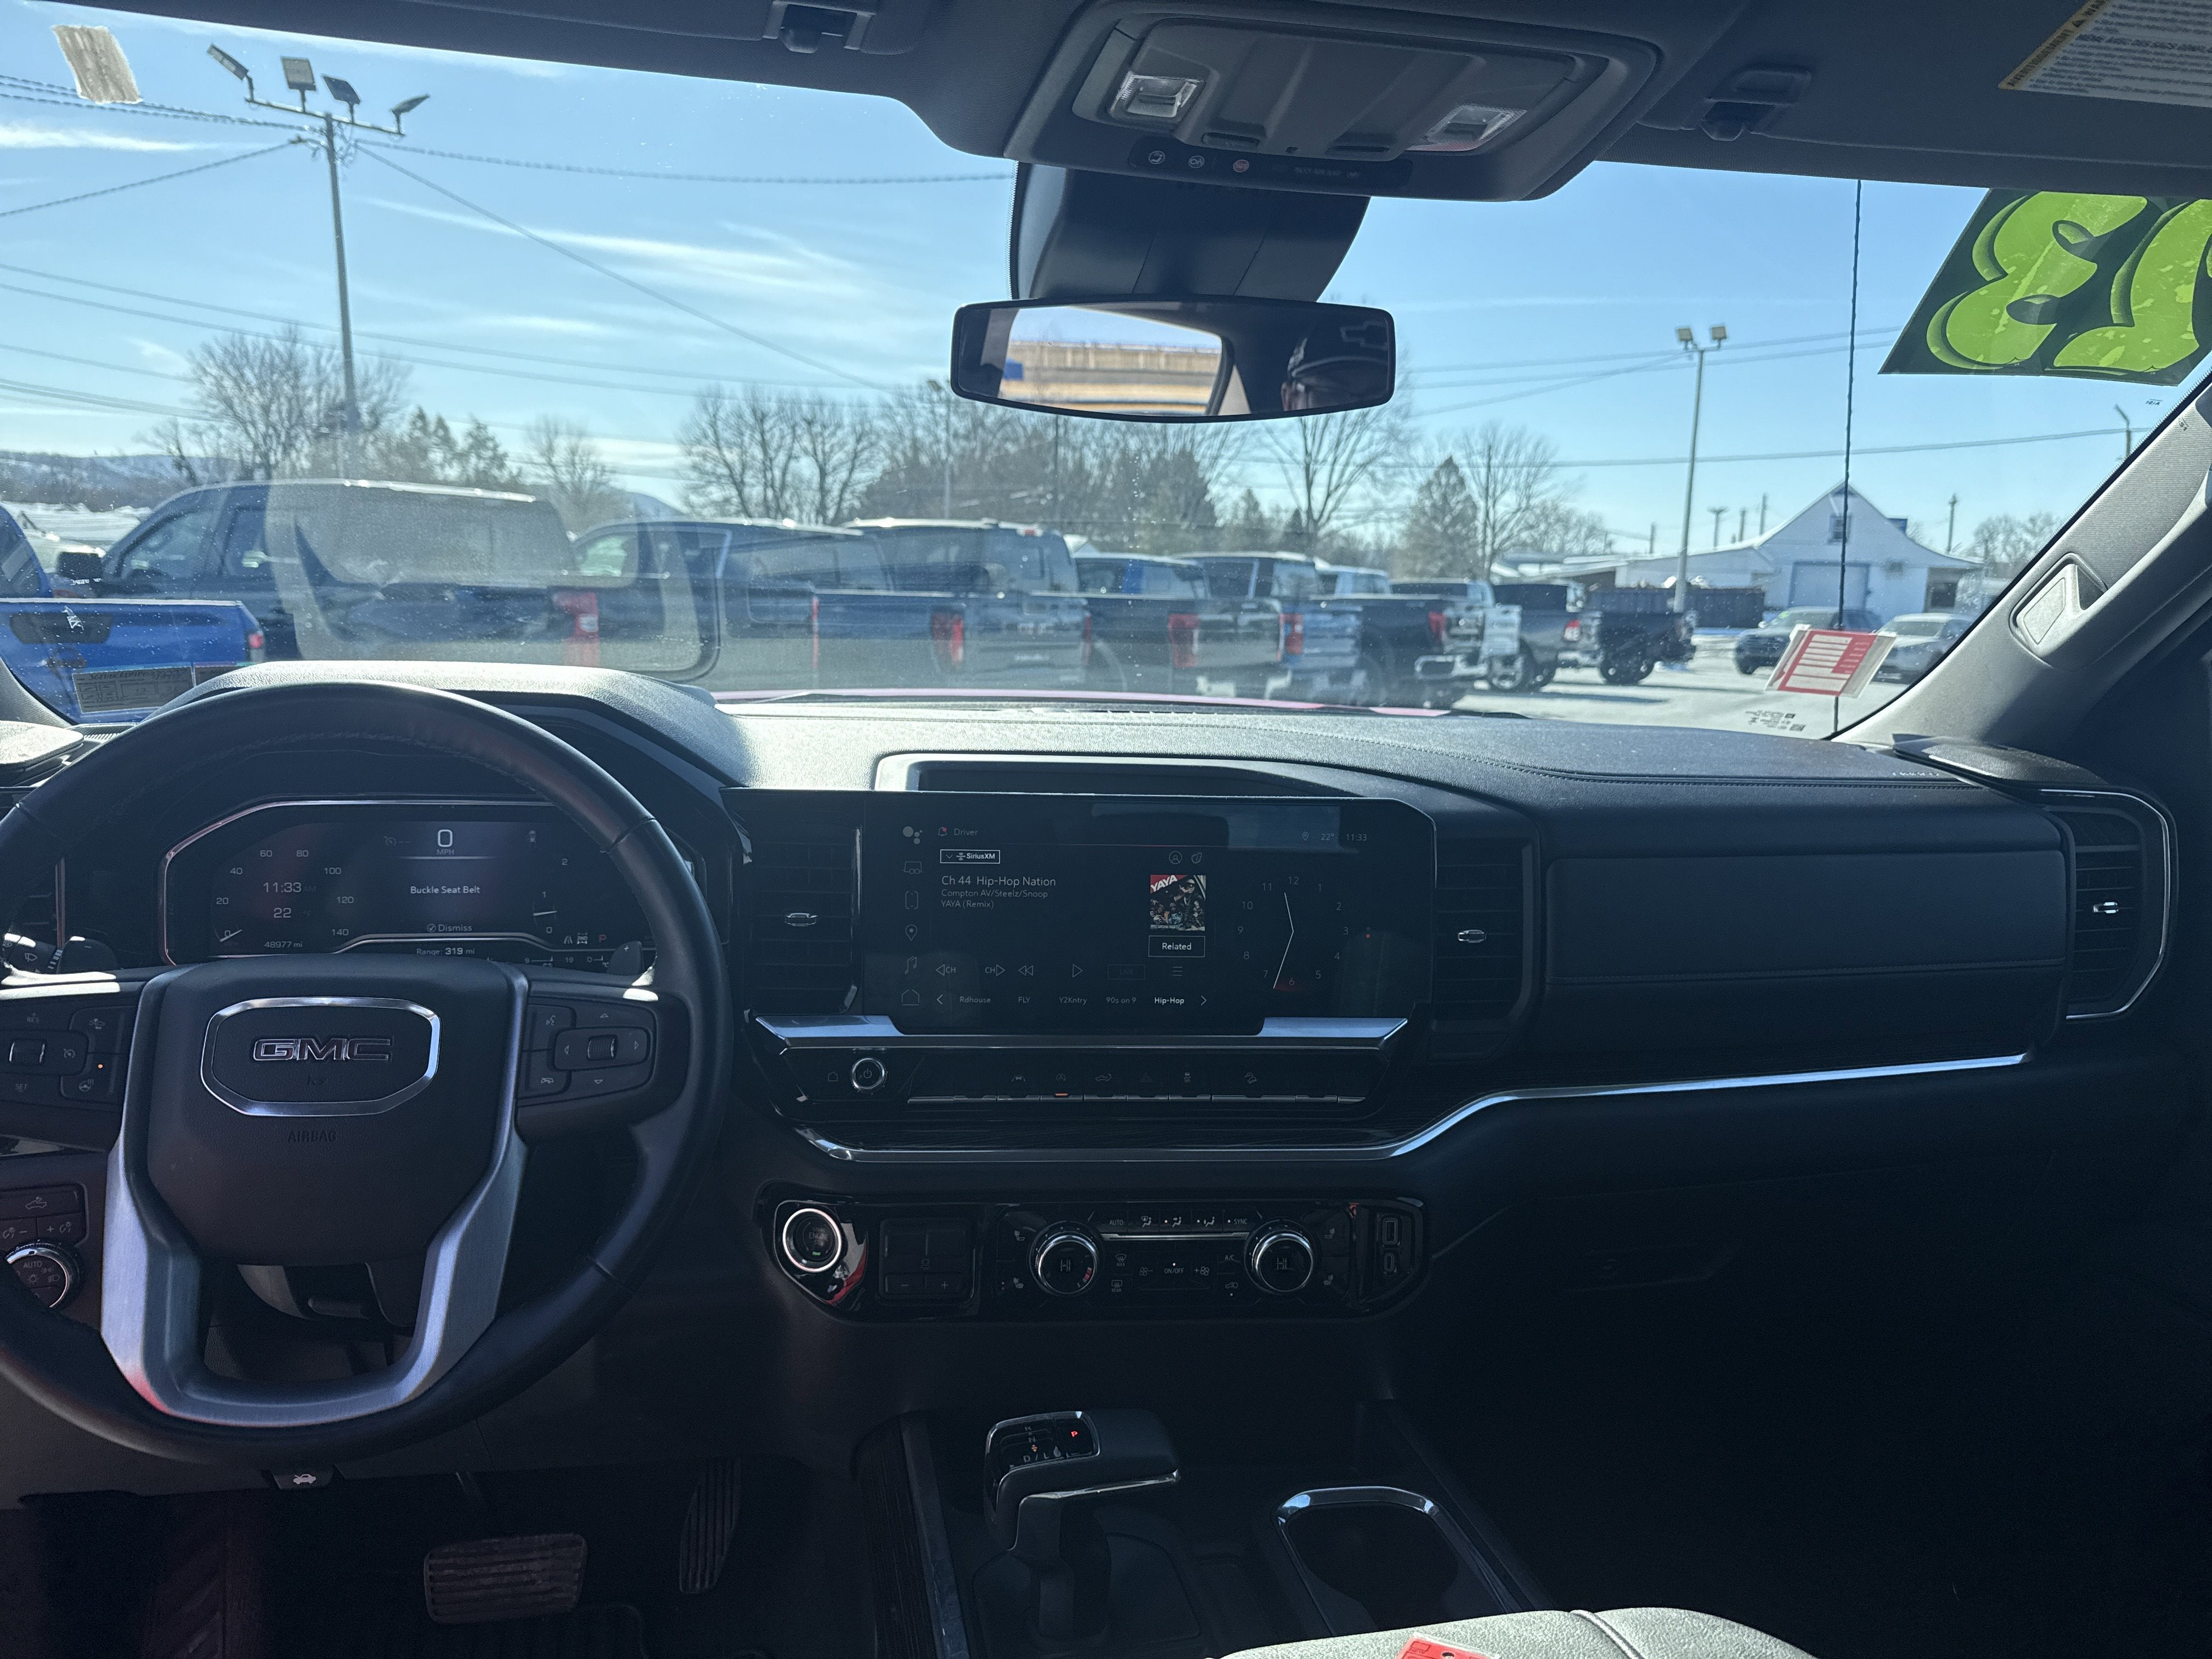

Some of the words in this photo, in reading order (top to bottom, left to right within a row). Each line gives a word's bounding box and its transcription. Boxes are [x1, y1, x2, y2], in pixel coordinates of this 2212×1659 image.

[953, 828, 978, 836] Driver
[437, 829, 453, 847] 0
[941, 876, 956, 885] Ch
[958, 876, 971, 885] 44
[977, 876, 1020, 888] Hip-Hop
[1023, 877, 1056, 887] Nation
[1150, 874, 1178, 893] YAYA
[1289, 876, 1299, 885] 12
[263, 882, 302, 893] 11:33
[463, 885, 480, 894] Belt
[1262, 883, 1272, 891] 11
[1318, 883, 1322, 891] 1
[941, 889, 978, 899] Compton
[980, 889, 1048, 899] AV/Steelz/Snoop
[963, 900, 994, 909] (Remix)
[1242, 901, 1253, 910] 10
[1336, 902, 1342, 911] 2
[274, 907, 292, 918] 22
[439, 924, 472, 932] Dismiss
[1237, 926, 1243, 934] 9
[1343, 927, 1348, 935] 3
[599, 934, 606, 943] P
[1161, 942, 1192, 950] Related
[1243, 951, 1250, 960] 8
[1334, 952, 1340, 960] 4
[1262, 969, 1268, 978] 7
[1315, 970, 1321, 979] 5
[1289, 978, 1295, 986] 6
[1059, 996, 1087, 1005] Y2Kntry
[1154, 996, 1184, 1006] Hip-Hop
[253, 1038, 392, 1062] GMC
[287, 1130, 337, 1143] AIRBAG
[23, 1261, 42, 1269] AUTO
